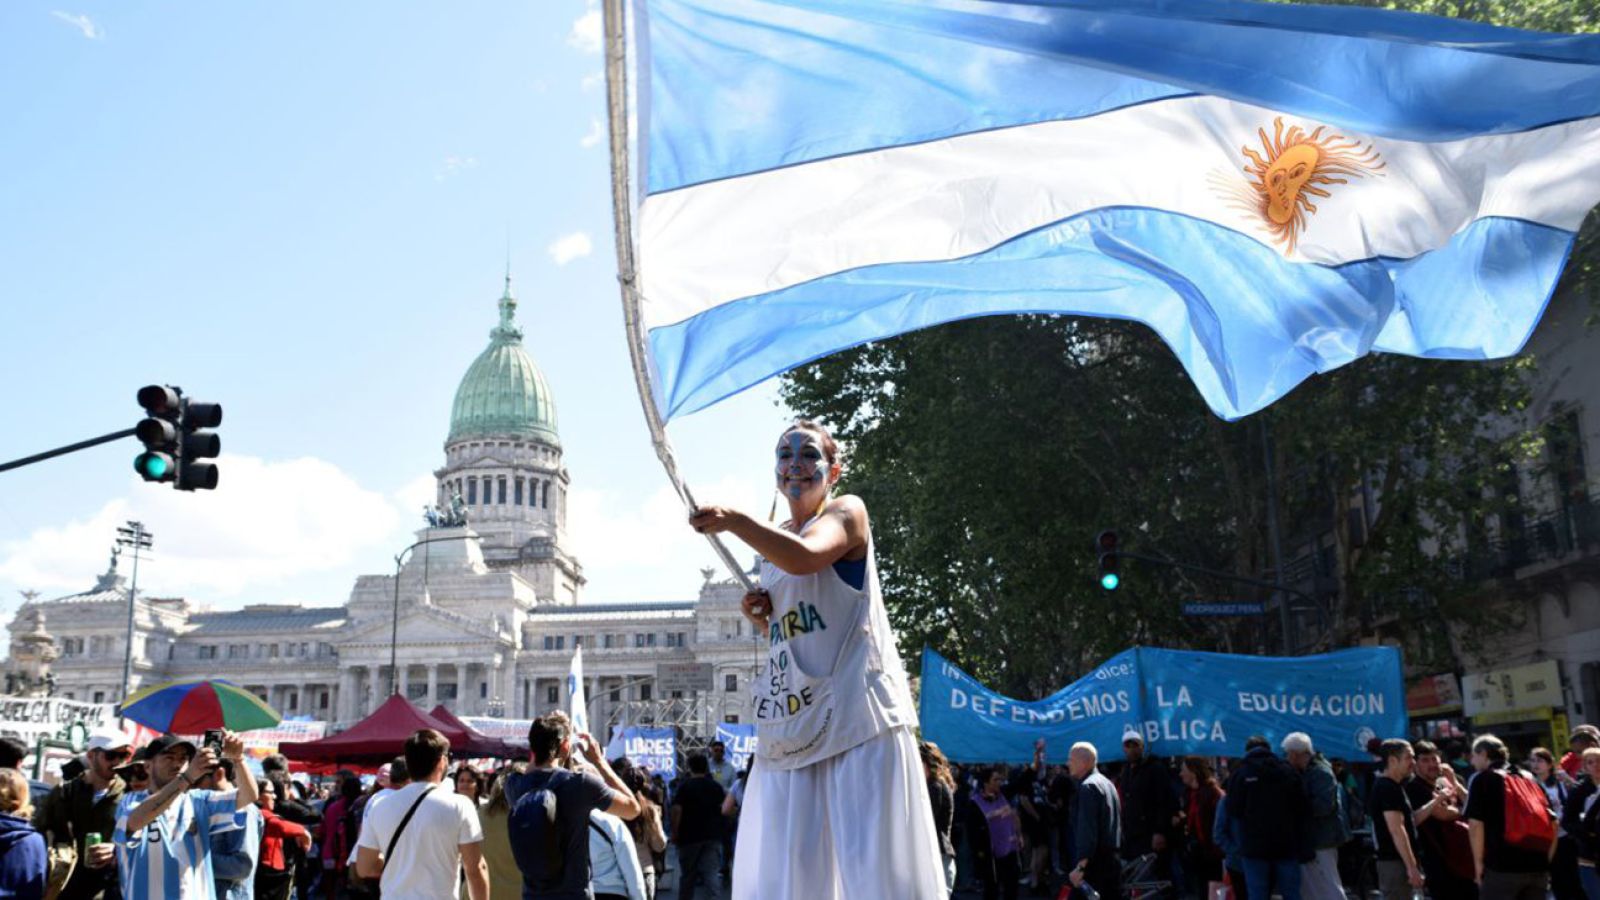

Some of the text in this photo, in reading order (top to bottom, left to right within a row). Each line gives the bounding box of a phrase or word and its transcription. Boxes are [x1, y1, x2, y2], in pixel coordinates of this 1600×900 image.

[770, 650, 788, 676] NO
[770, 672, 789, 696] SE
[951, 685, 1385, 724] DEFENDEMOS LA EDUCACIÓN
[625, 736, 674, 755] LIBRES
[647, 756, 674, 772] SUR
[147, 820, 161, 843] 5
